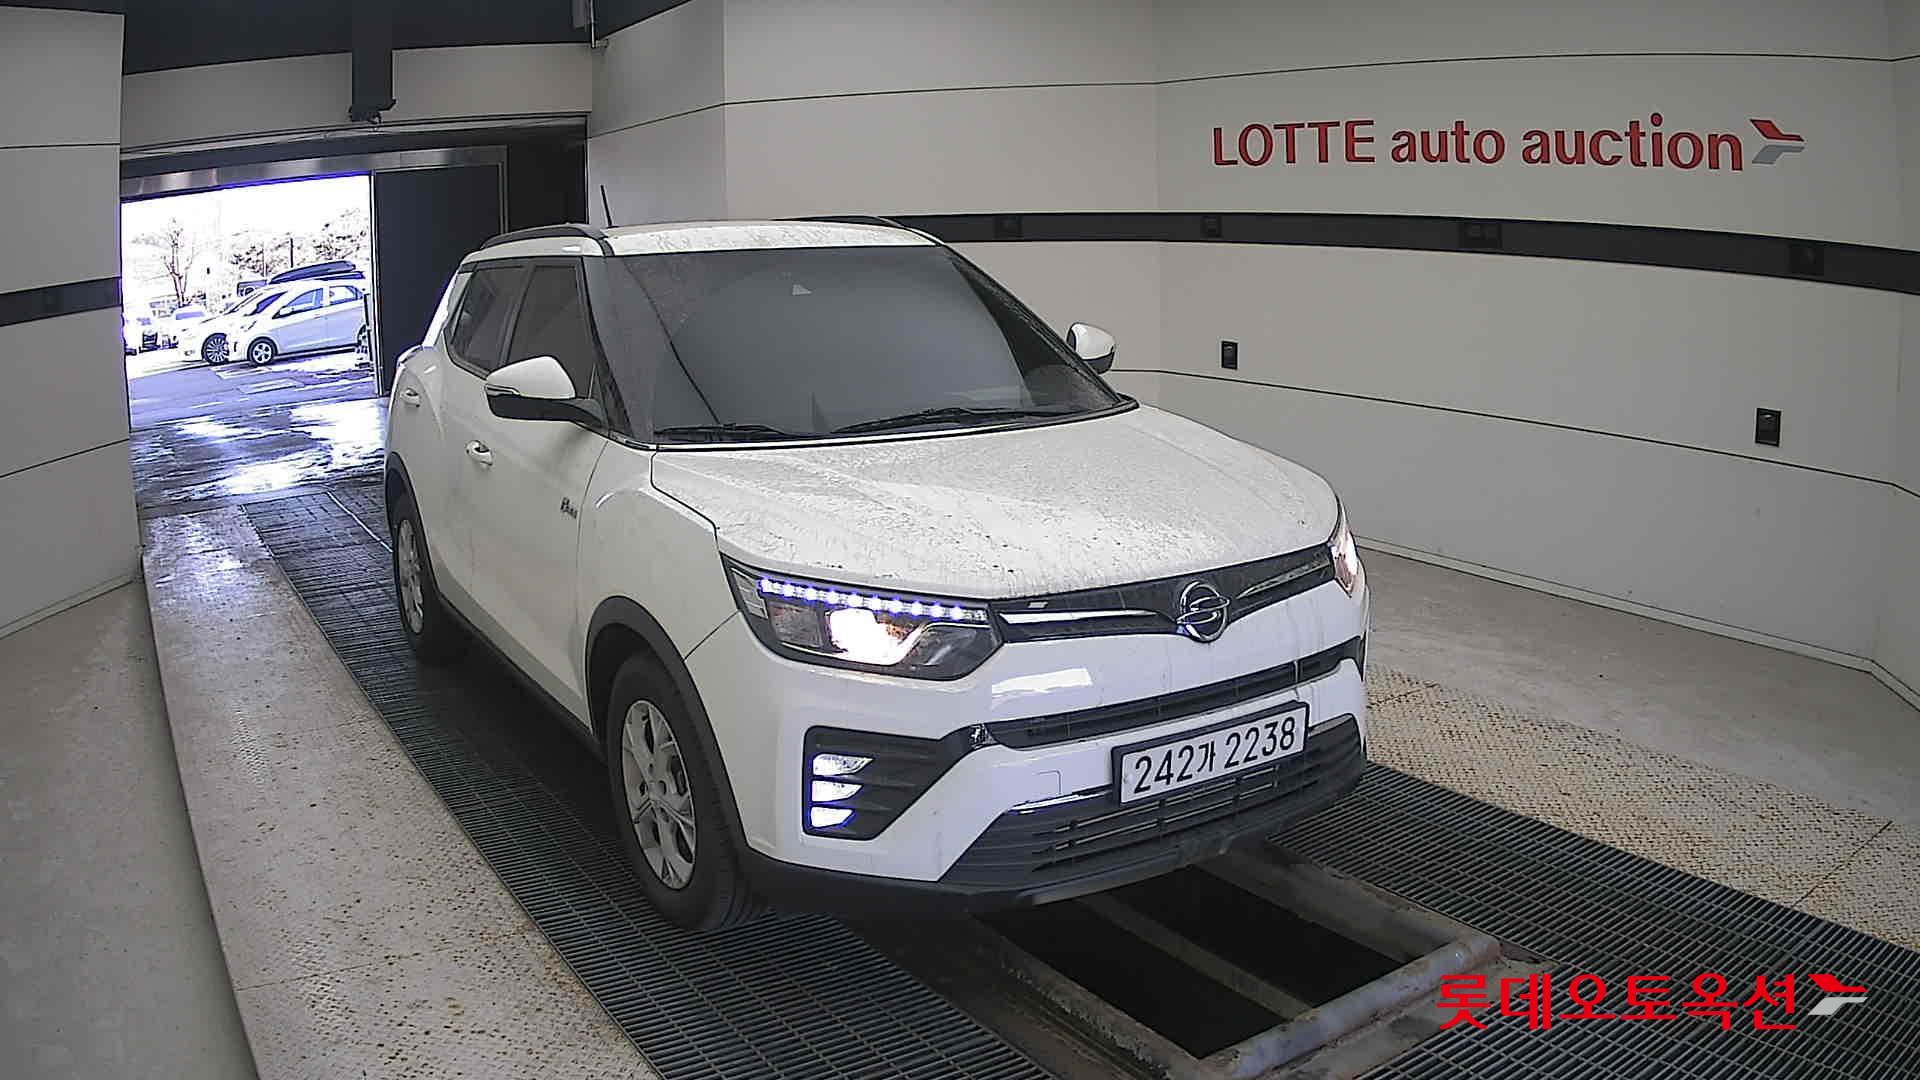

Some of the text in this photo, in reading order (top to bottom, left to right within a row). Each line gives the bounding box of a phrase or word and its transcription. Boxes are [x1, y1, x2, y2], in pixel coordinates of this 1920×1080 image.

[1212, 112, 1744, 171] LOTTE auto auction
[1133, 716, 1297, 794] 242가 2238
